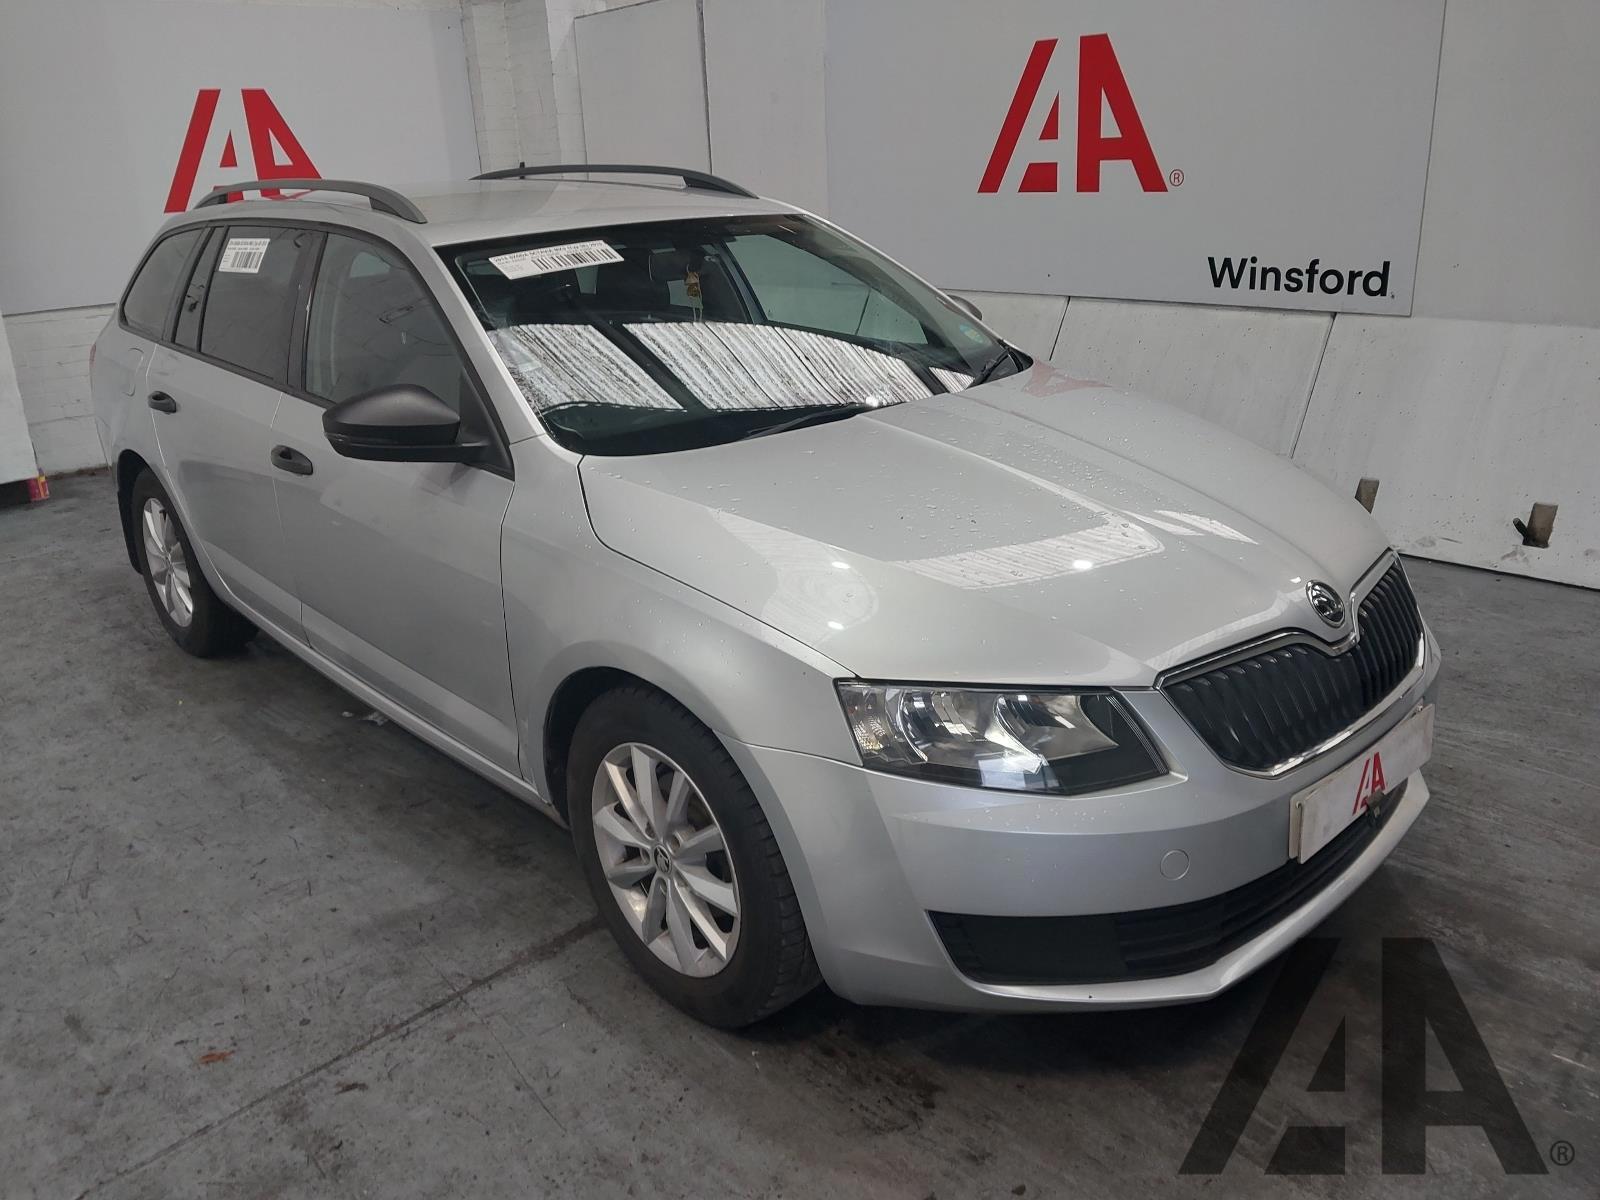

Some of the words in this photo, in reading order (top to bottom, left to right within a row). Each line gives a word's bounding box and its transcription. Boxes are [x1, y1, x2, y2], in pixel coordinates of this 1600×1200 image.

[164, 88, 322, 213] AA
[977, 33, 1168, 193] AA
[1207, 255, 1391, 298] Winsford
